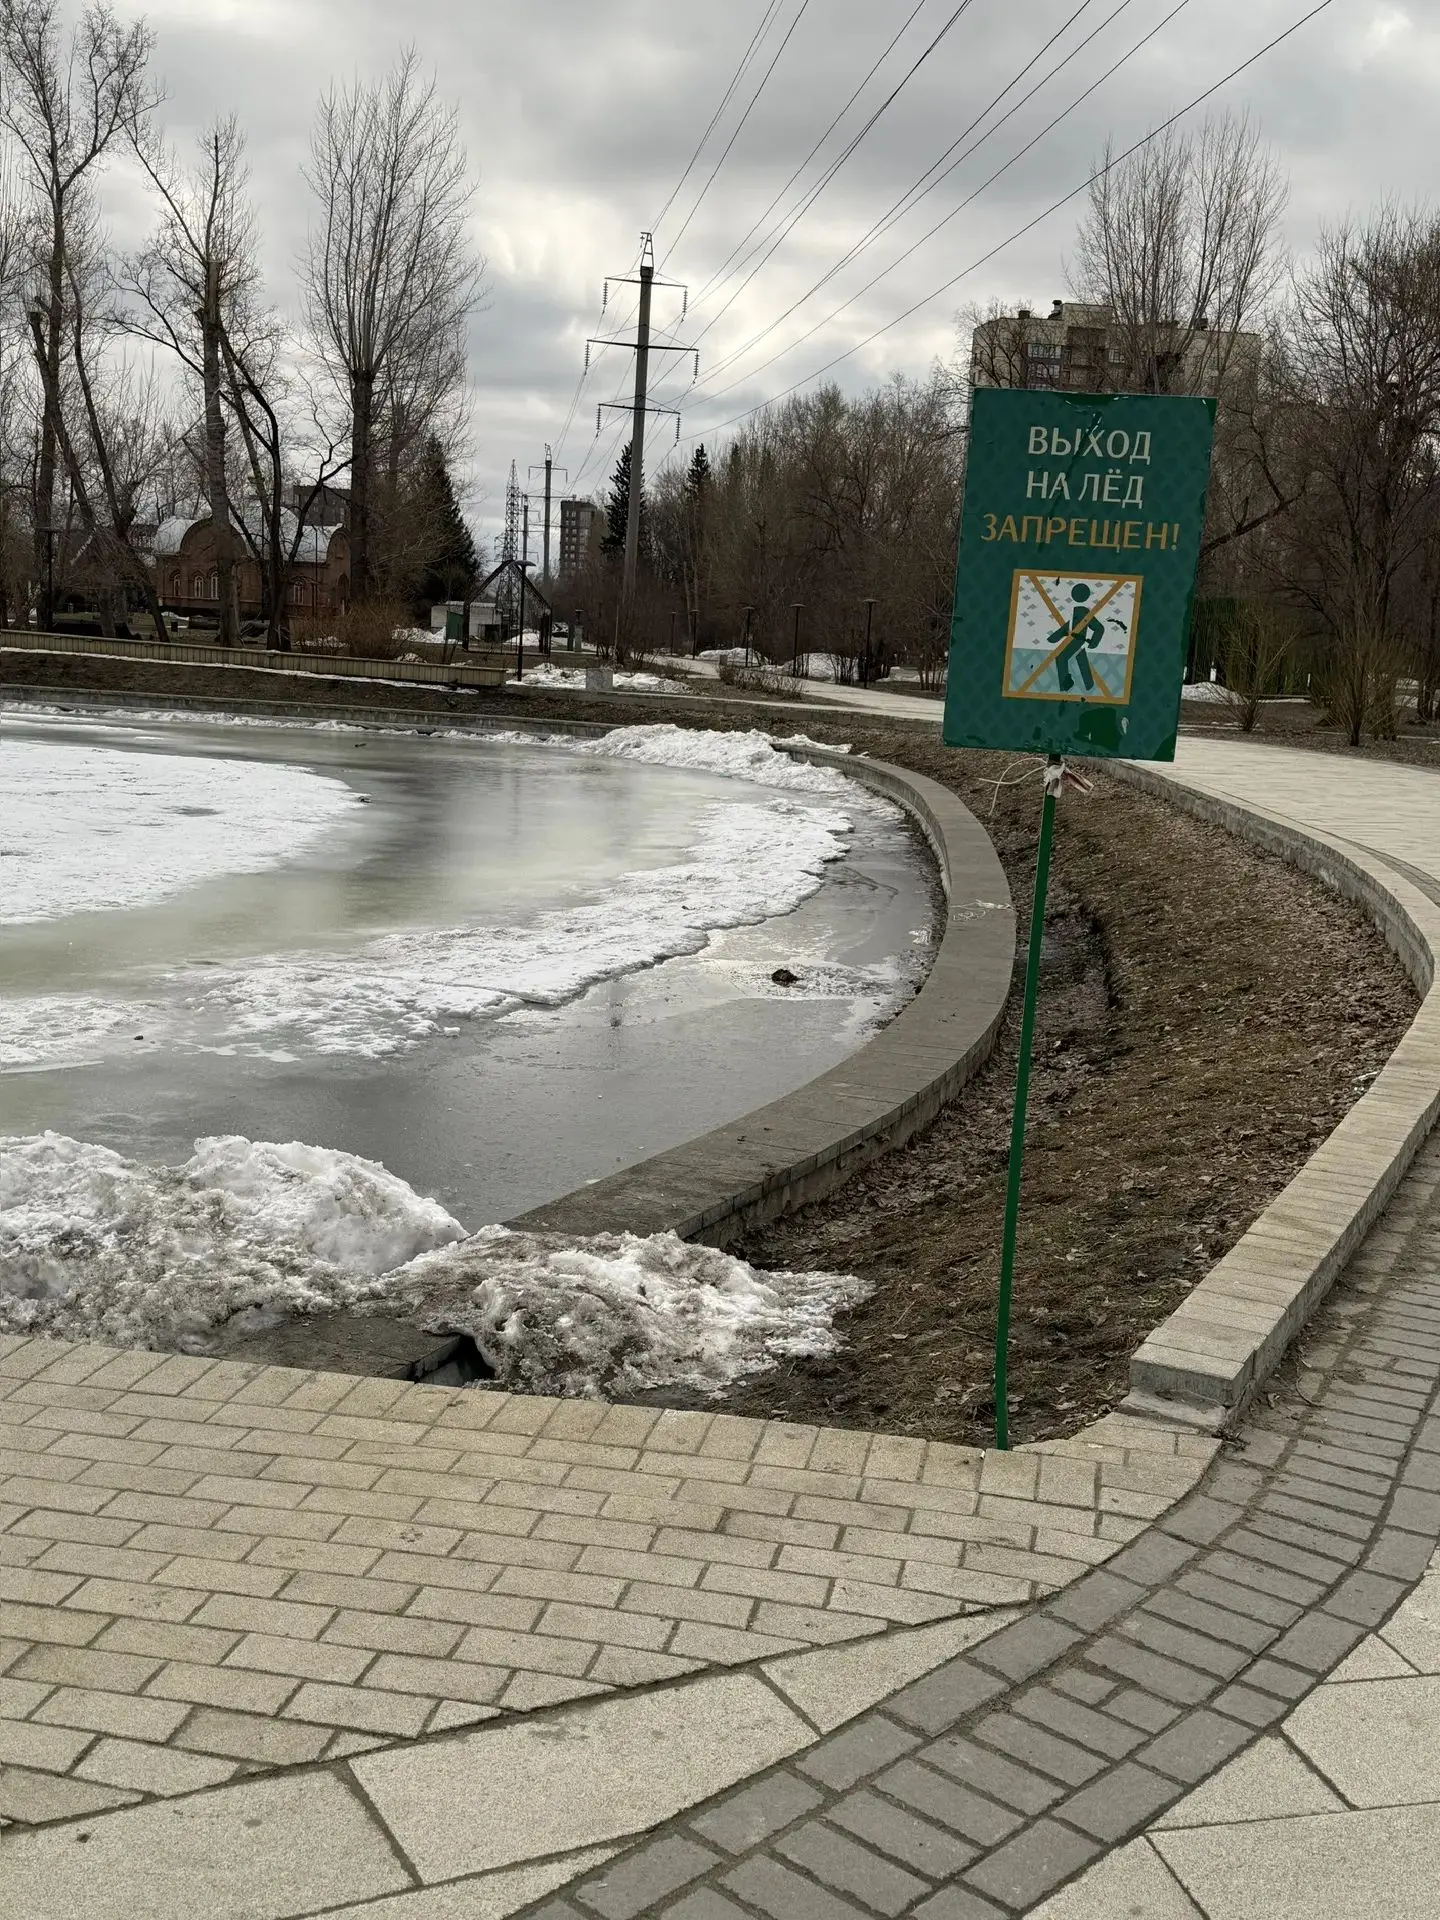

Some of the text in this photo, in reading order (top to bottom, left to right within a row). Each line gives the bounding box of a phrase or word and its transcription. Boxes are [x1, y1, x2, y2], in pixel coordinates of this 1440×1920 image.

[1028, 426, 1152, 465] ВЫХОД
[1026, 468, 1144, 509] НА ЛЁД
[981, 513, 1180, 553] ЗАПРЕЩЕН!
